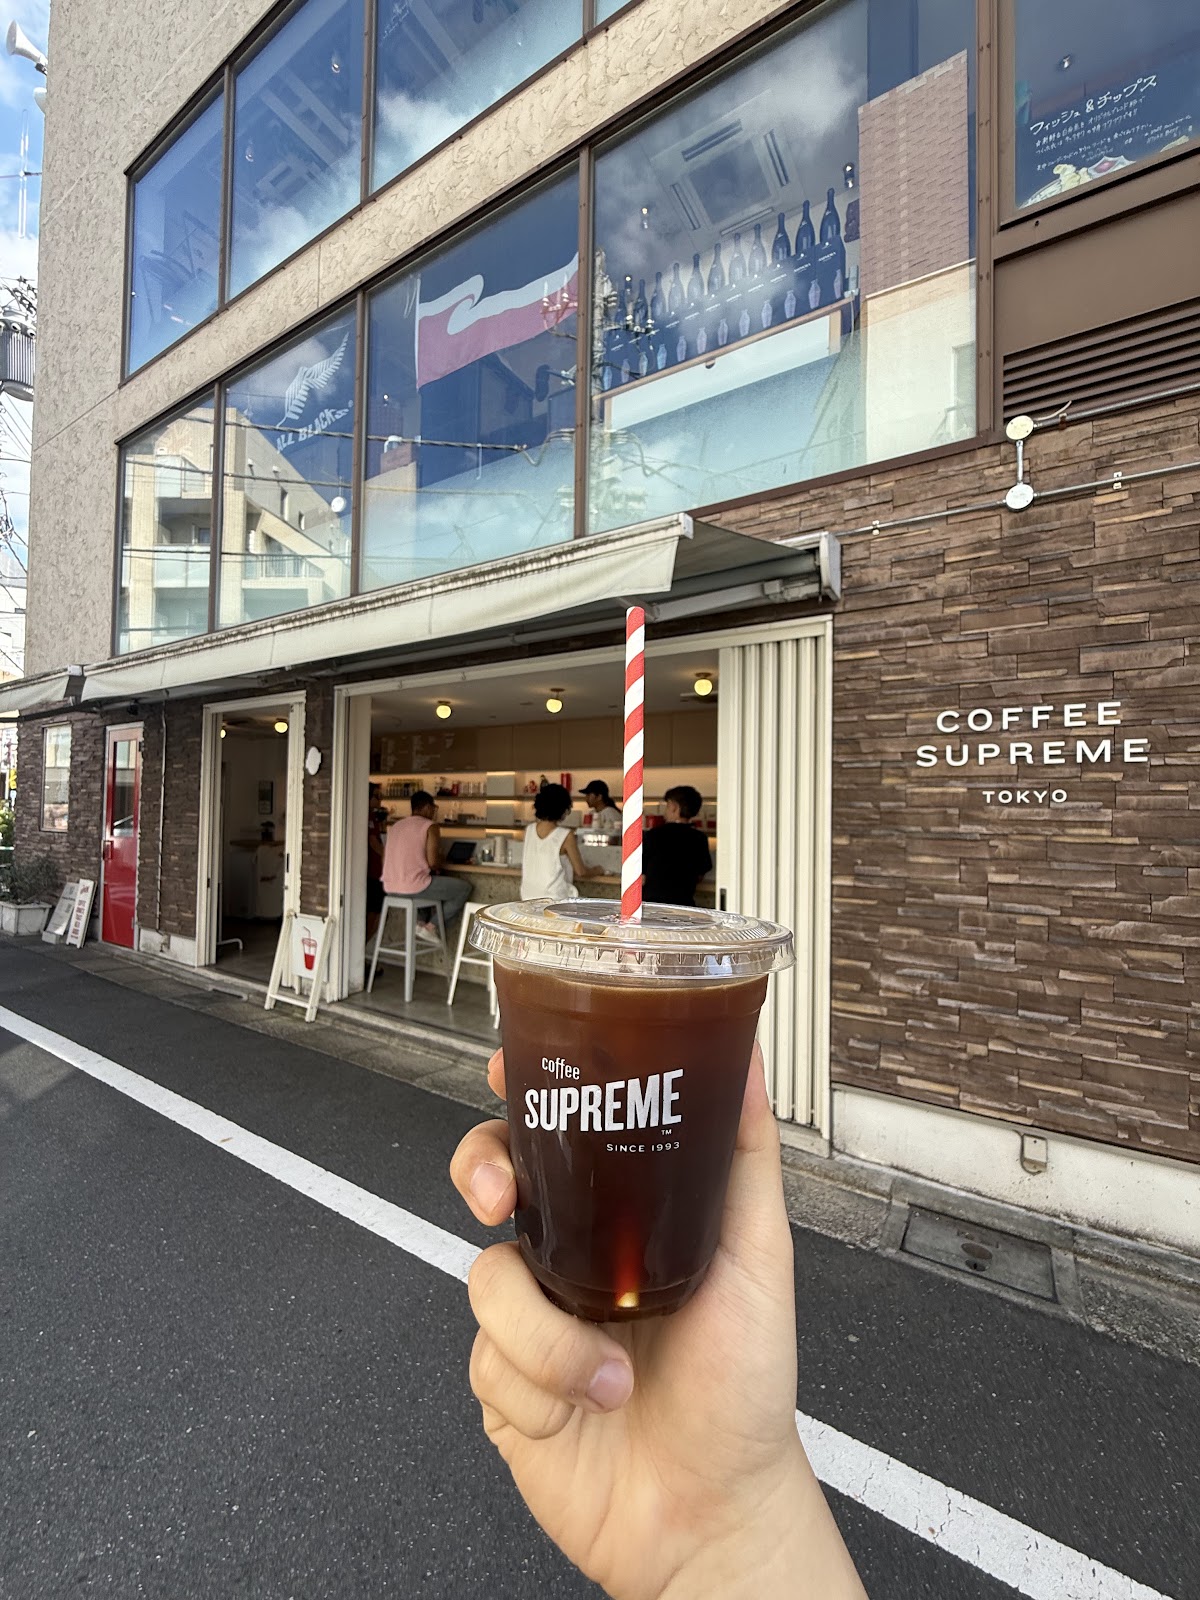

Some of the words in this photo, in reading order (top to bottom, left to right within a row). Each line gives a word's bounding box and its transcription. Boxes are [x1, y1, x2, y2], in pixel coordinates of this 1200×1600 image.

[276, 432, 295, 454] ALL
[298, 408, 349, 442] BLACKS
[936, 701, 1122, 733] COFFEE
[916, 738, 1149, 767] SUPREME
[982, 789, 1068, 804] TOKYO
[541, 1057, 580, 1080] coffee
[524, 1068, 684, 1132] SUPREME
[606, 1143, 645, 1153] SINCE
[651, 1141, 680, 1152] 1993
